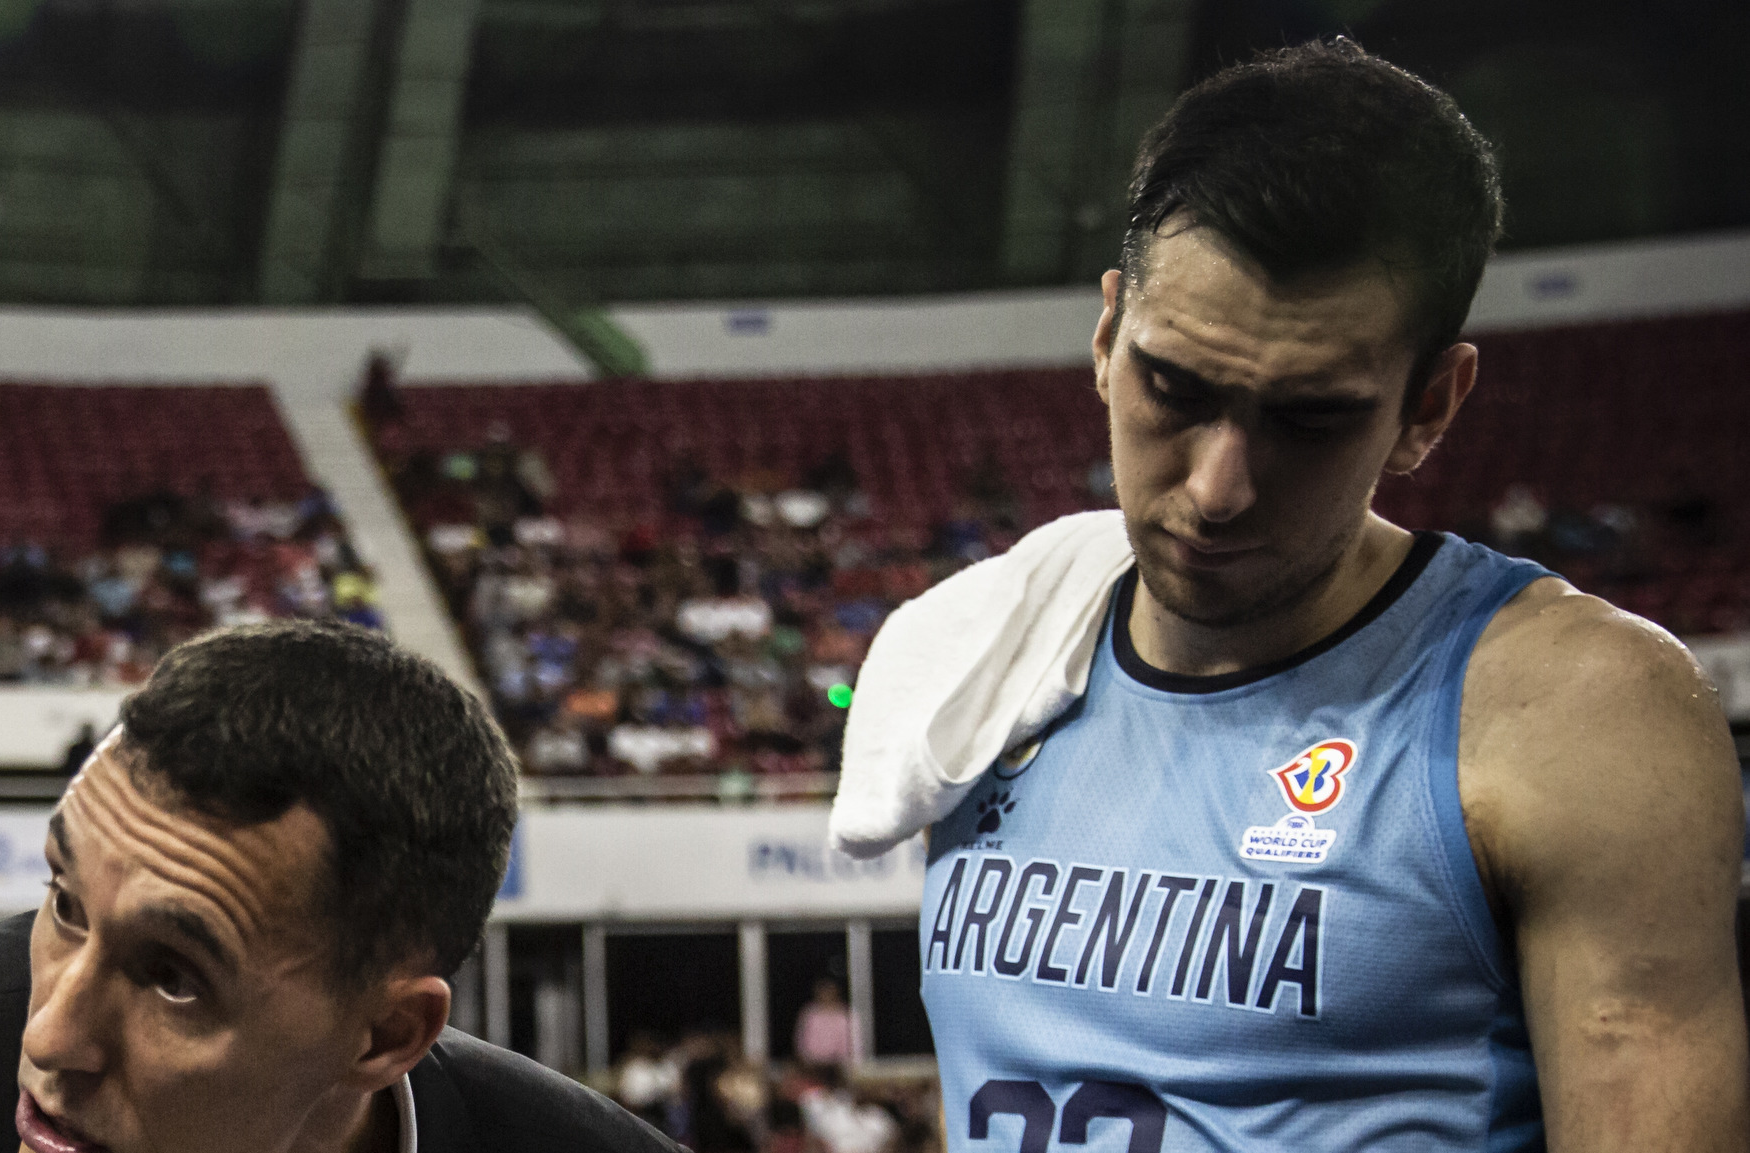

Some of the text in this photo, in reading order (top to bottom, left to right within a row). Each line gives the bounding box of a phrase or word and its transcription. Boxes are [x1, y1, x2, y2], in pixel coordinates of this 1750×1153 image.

[1250, 835, 1327, 848] WORLD CUP
[925, 854, 1326, 1019] ARGENTINA
